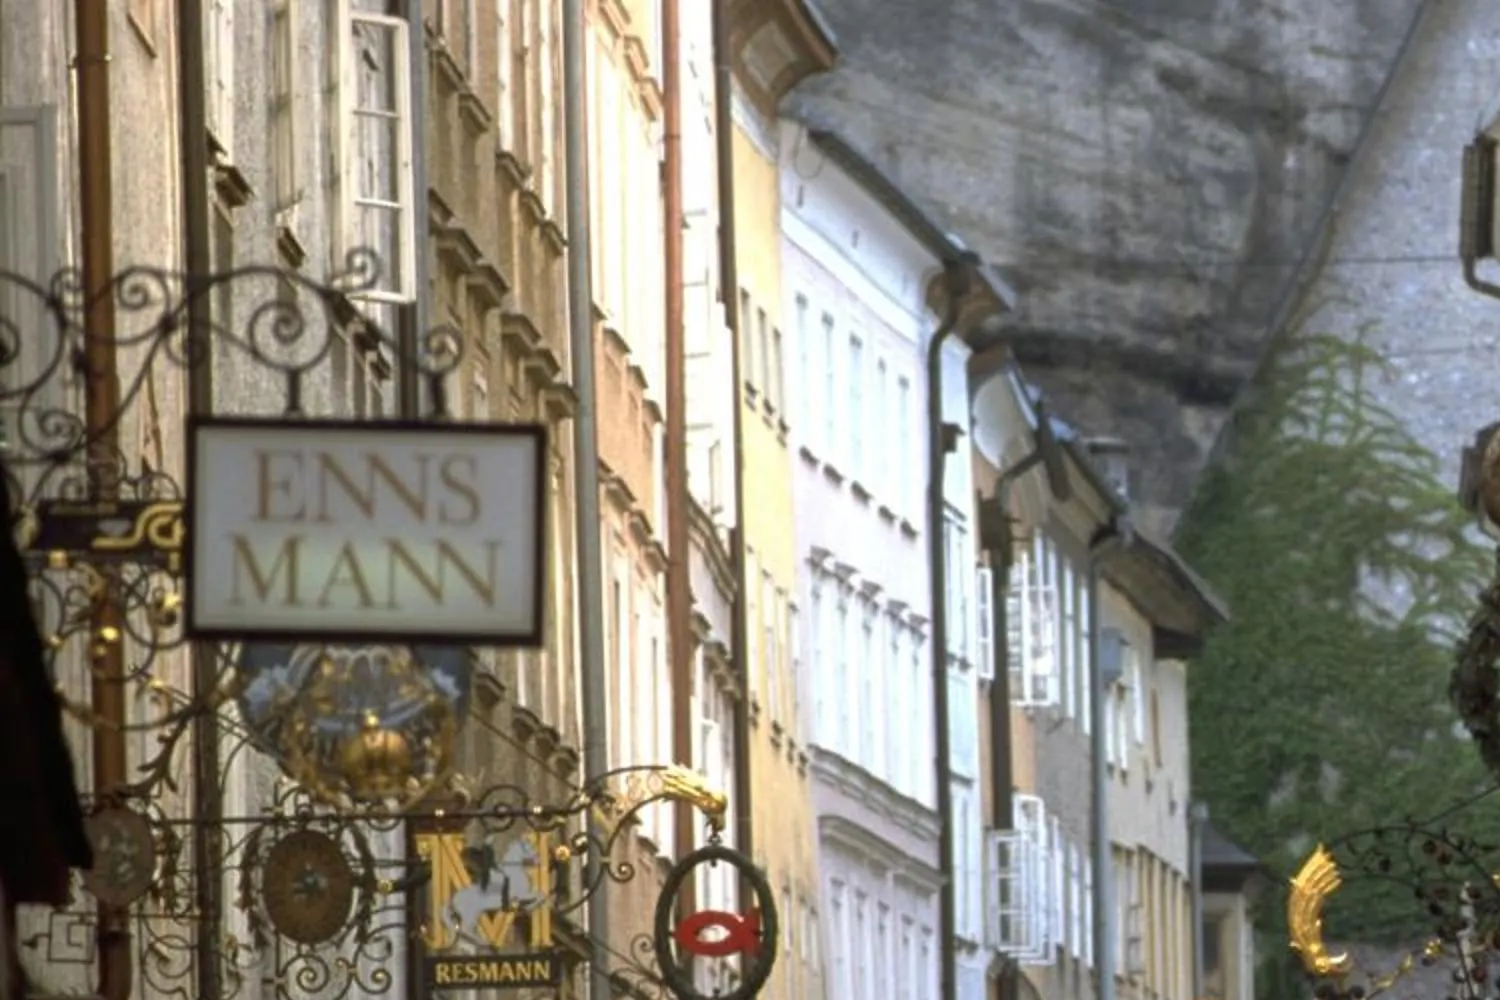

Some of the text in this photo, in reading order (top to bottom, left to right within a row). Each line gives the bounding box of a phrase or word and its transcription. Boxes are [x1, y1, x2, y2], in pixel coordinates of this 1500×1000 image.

[251, 449, 481, 527] ENNS
[225, 530, 504, 609] MANN
[435, 961, 550, 984] RESMANN
